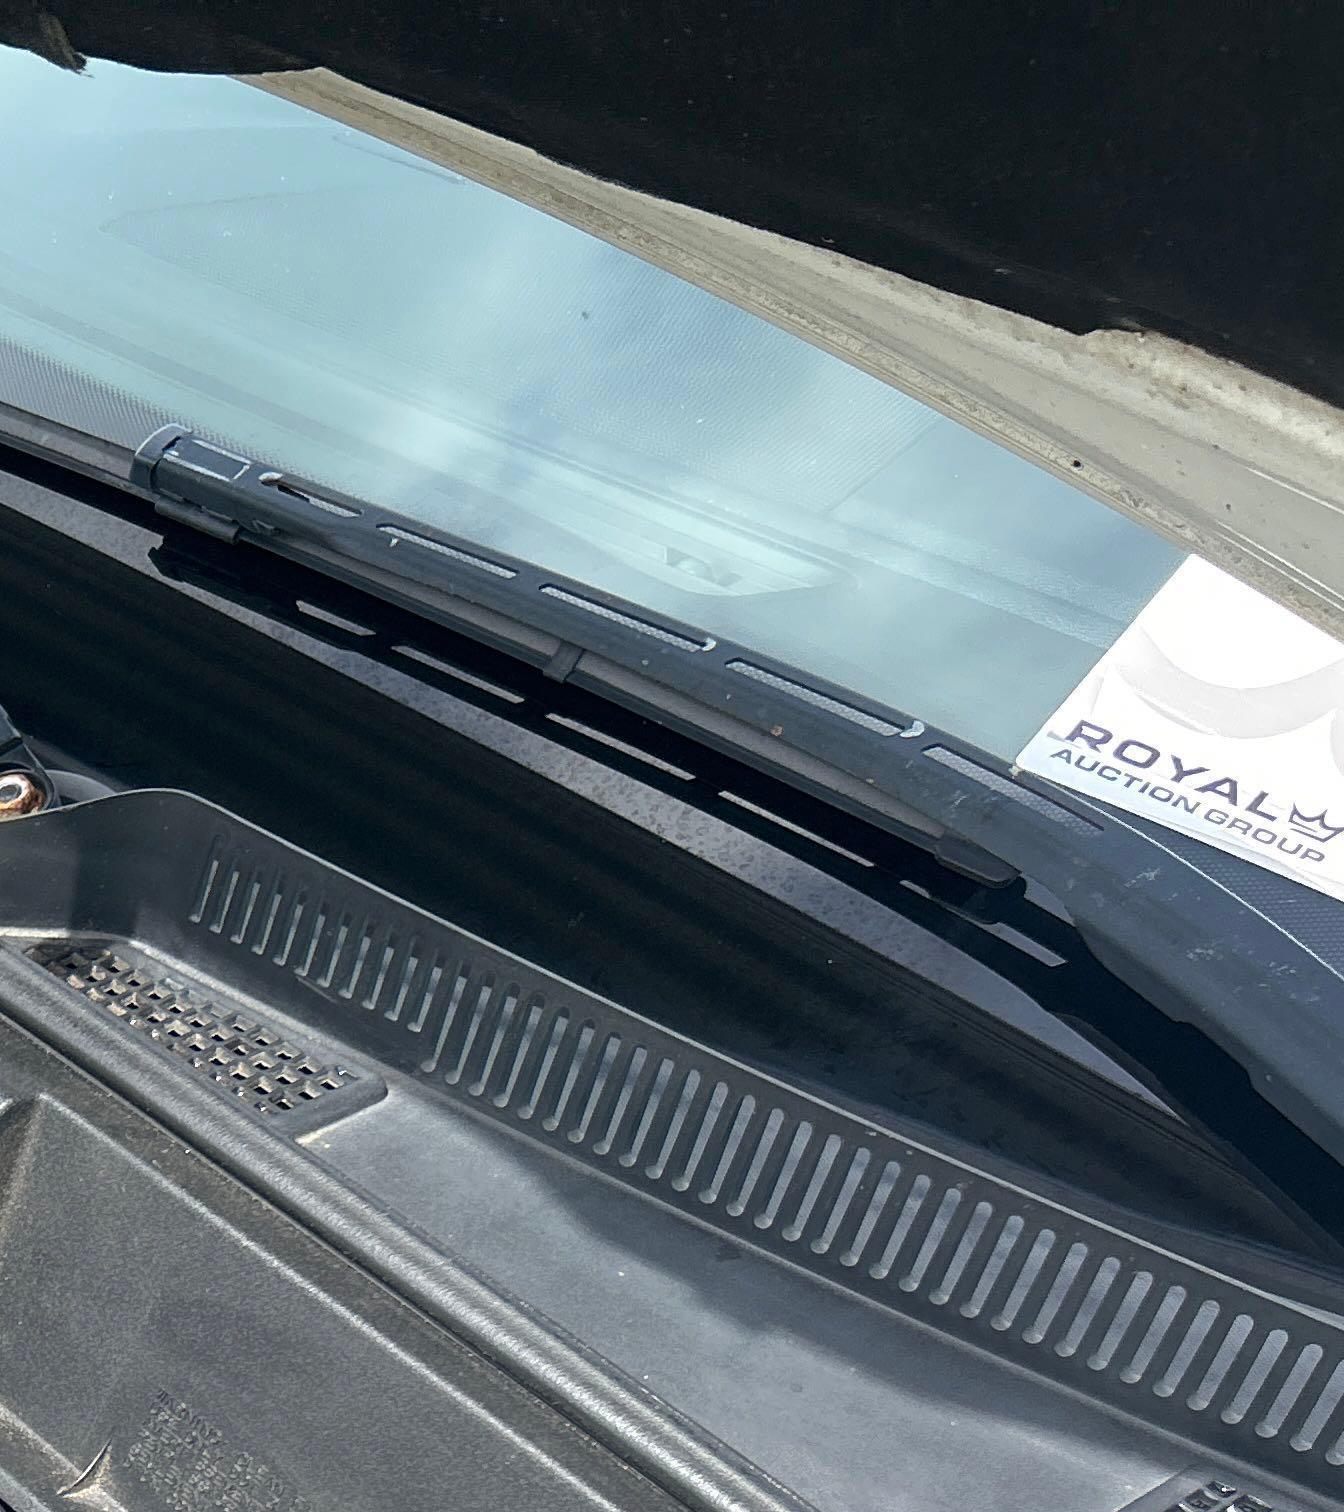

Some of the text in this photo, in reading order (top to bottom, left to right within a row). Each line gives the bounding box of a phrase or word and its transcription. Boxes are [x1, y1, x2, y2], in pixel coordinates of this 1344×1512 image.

[1047, 748, 1326, 864] AUCTION GROUP
[1064, 719, 1279, 823] ROYAL
